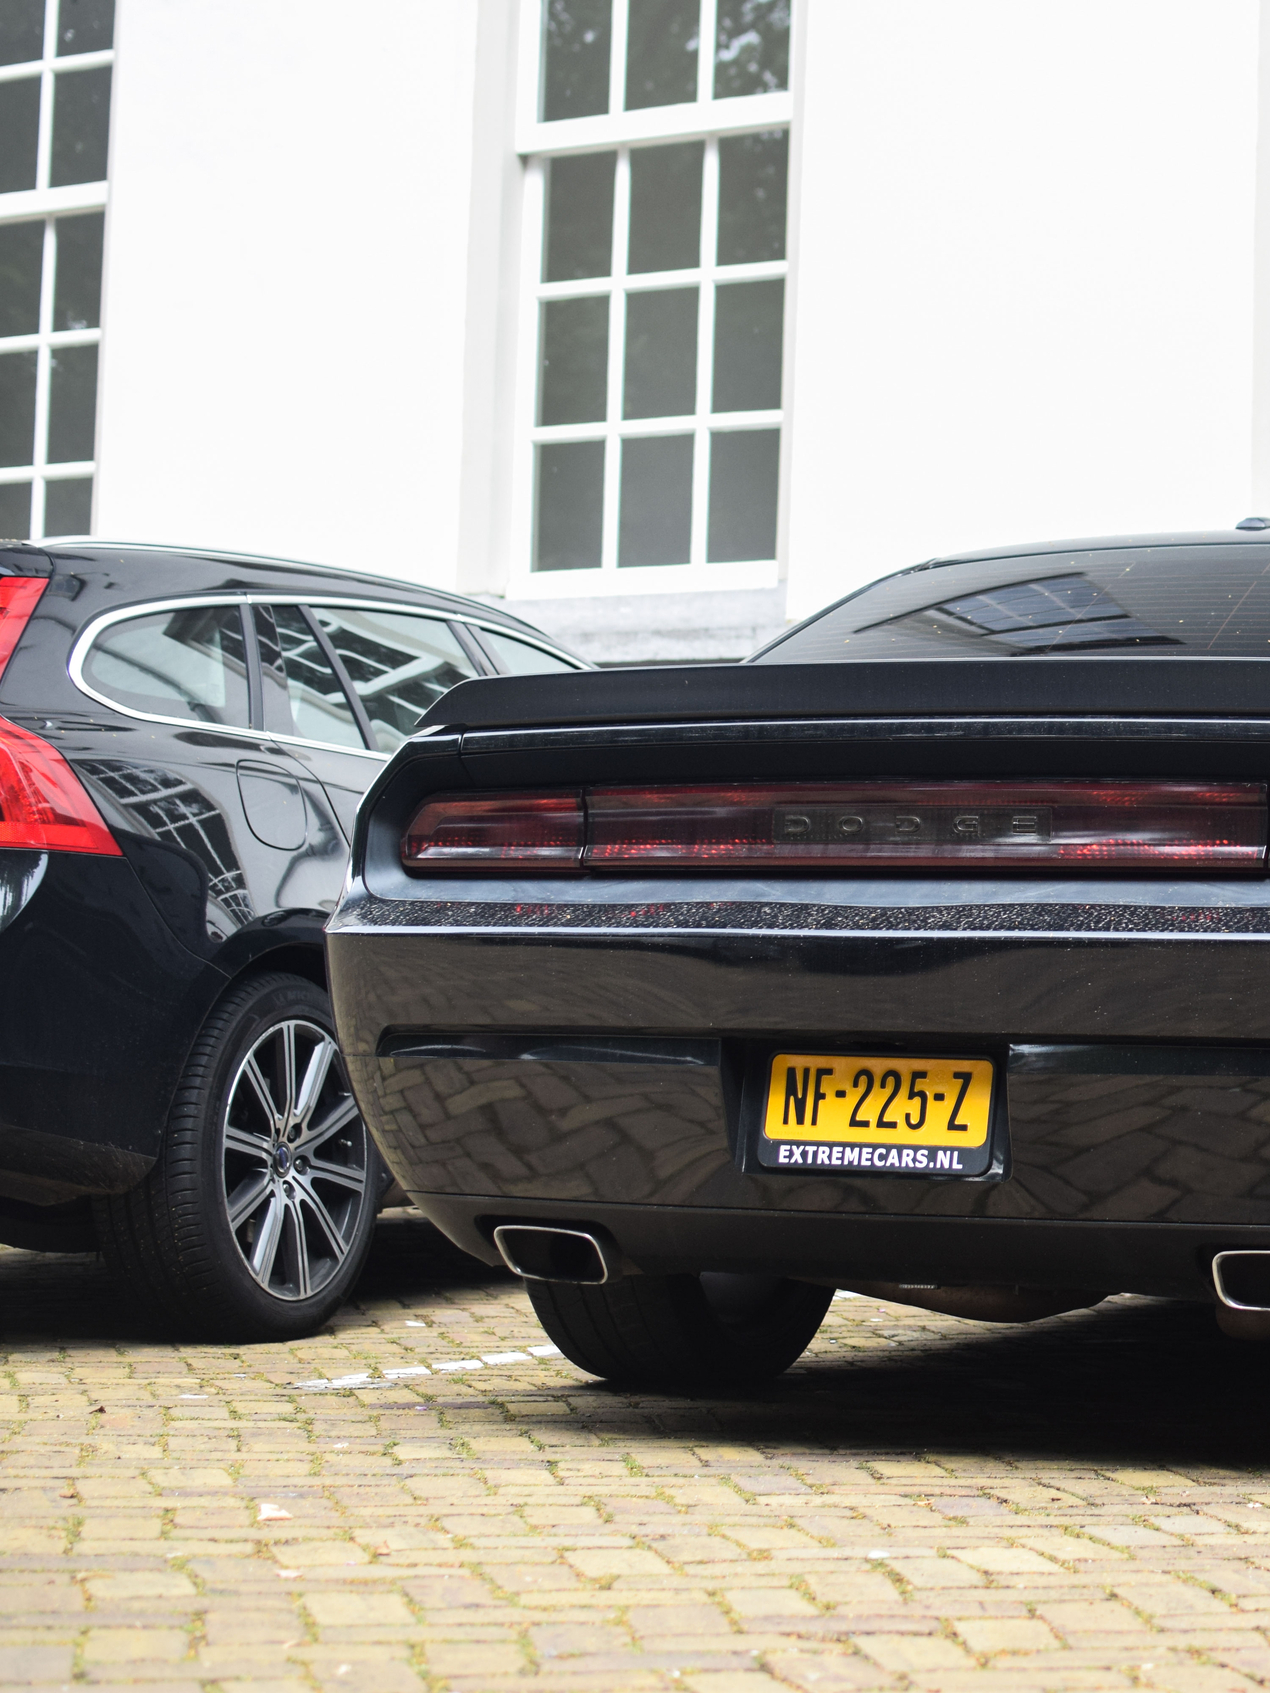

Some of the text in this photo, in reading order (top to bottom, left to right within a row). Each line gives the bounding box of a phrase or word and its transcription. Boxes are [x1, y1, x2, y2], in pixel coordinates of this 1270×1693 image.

[784, 815, 1037, 834] DODGE
[782, 1067, 973, 1132] NF-225-Z
[778, 1145, 963, 1169] EXTREMECARS.NL
